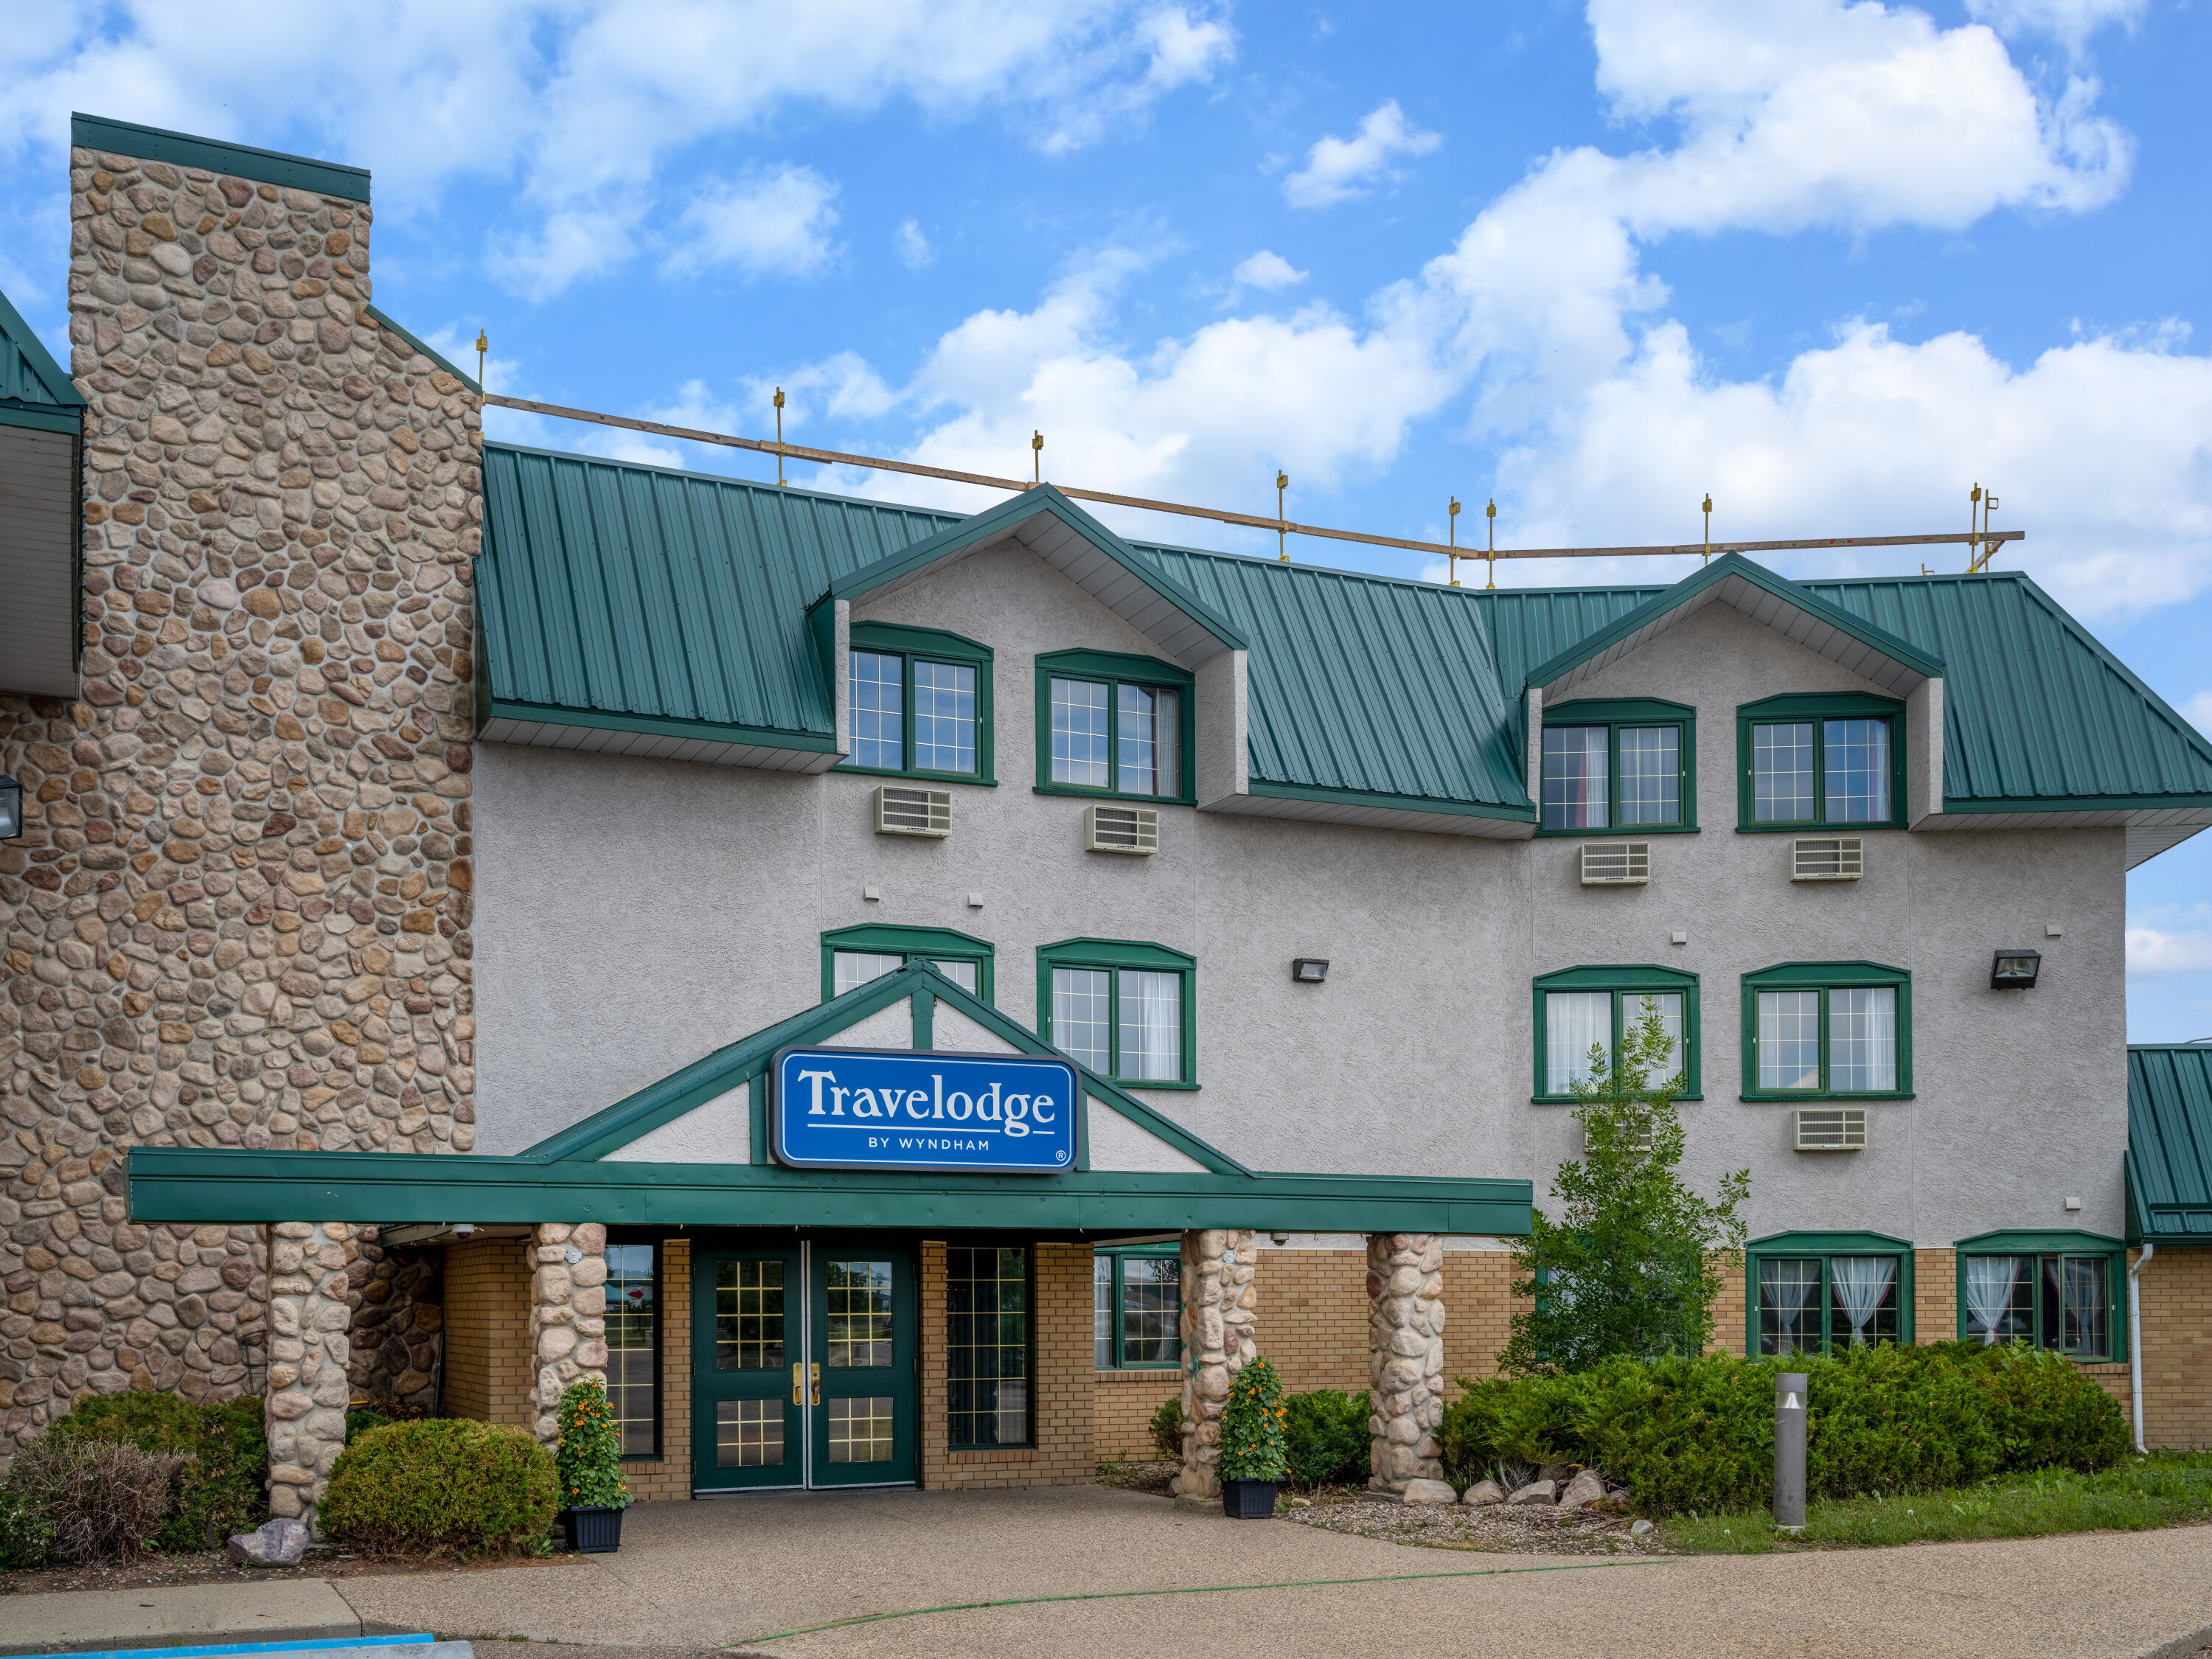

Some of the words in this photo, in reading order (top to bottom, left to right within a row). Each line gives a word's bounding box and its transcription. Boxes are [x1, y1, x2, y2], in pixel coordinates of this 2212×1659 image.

[797, 1069, 1055, 1138] Travelodge
[869, 1137, 889, 1148] BY
[899, 1138, 989, 1151] WYNDHAM
